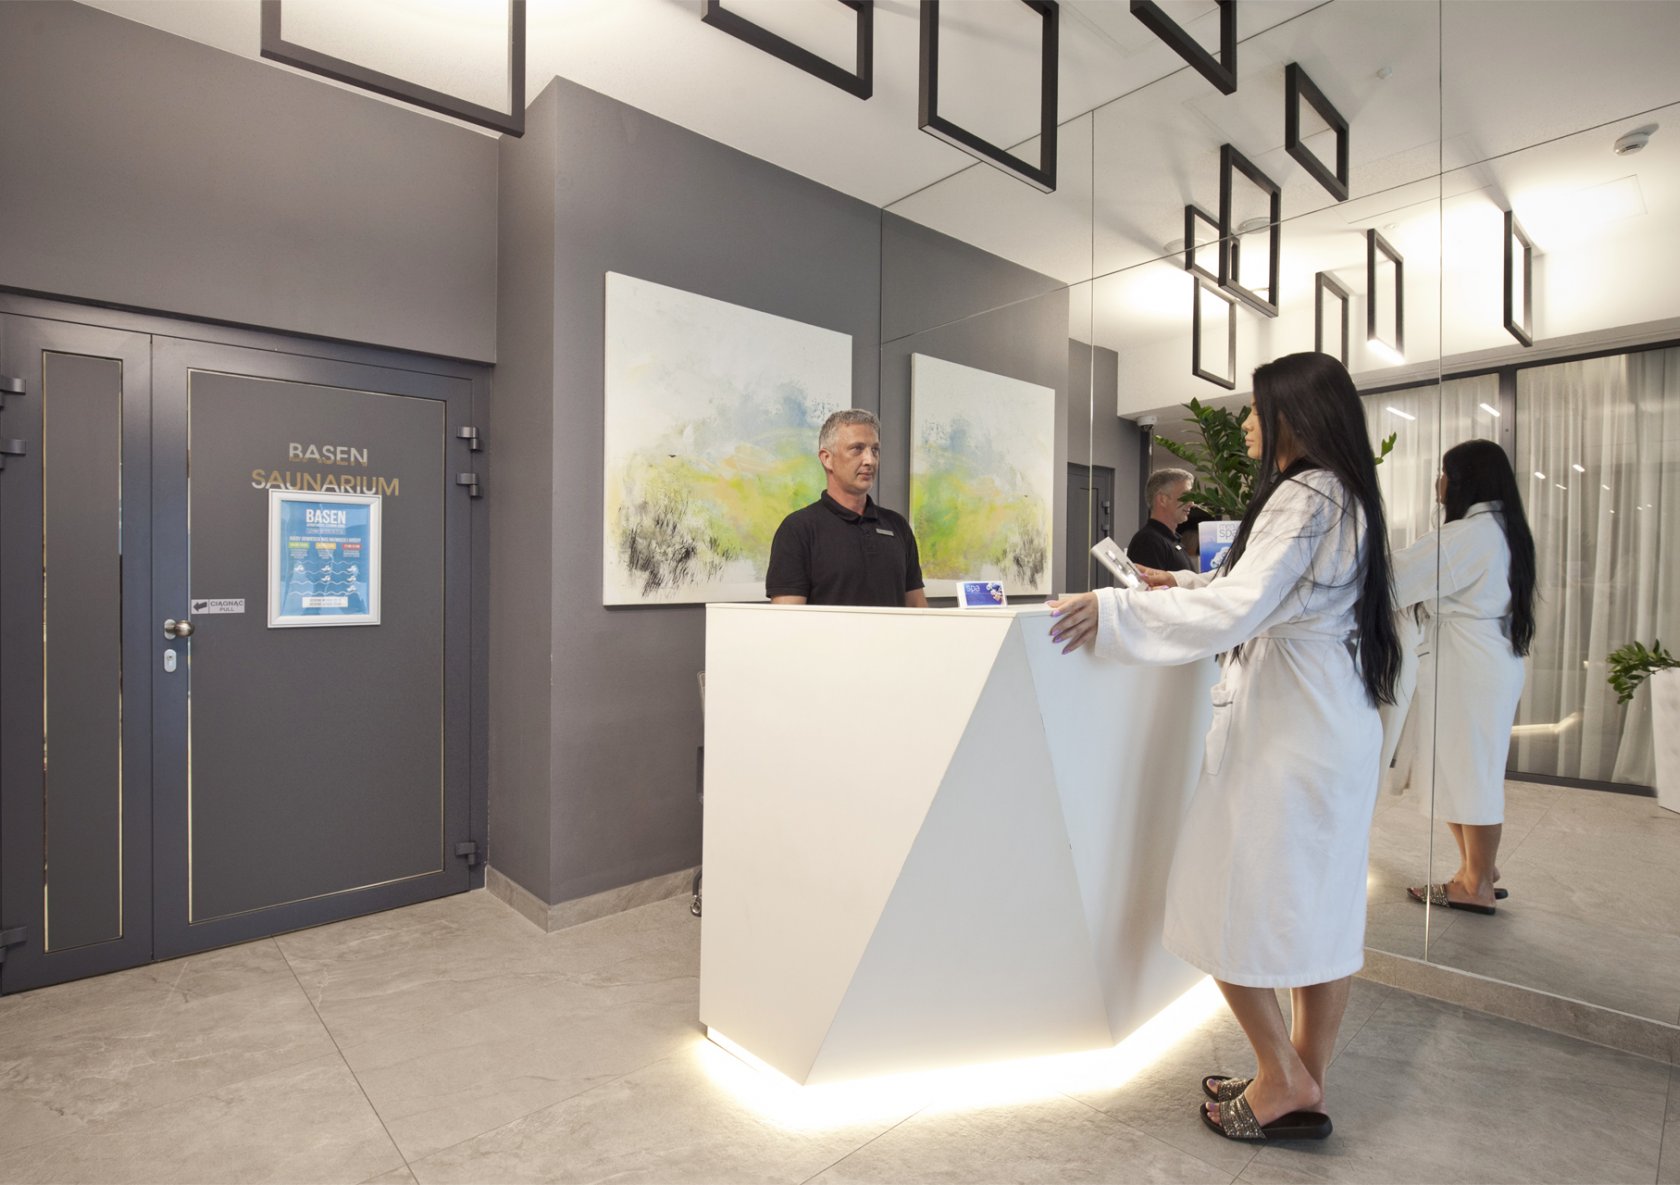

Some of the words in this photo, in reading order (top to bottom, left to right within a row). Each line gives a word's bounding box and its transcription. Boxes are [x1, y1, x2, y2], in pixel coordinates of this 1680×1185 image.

[289, 442, 368, 467] BASEN
[251, 469, 399, 496] SAUNARIUM
[306, 509, 346, 524] BASEN
